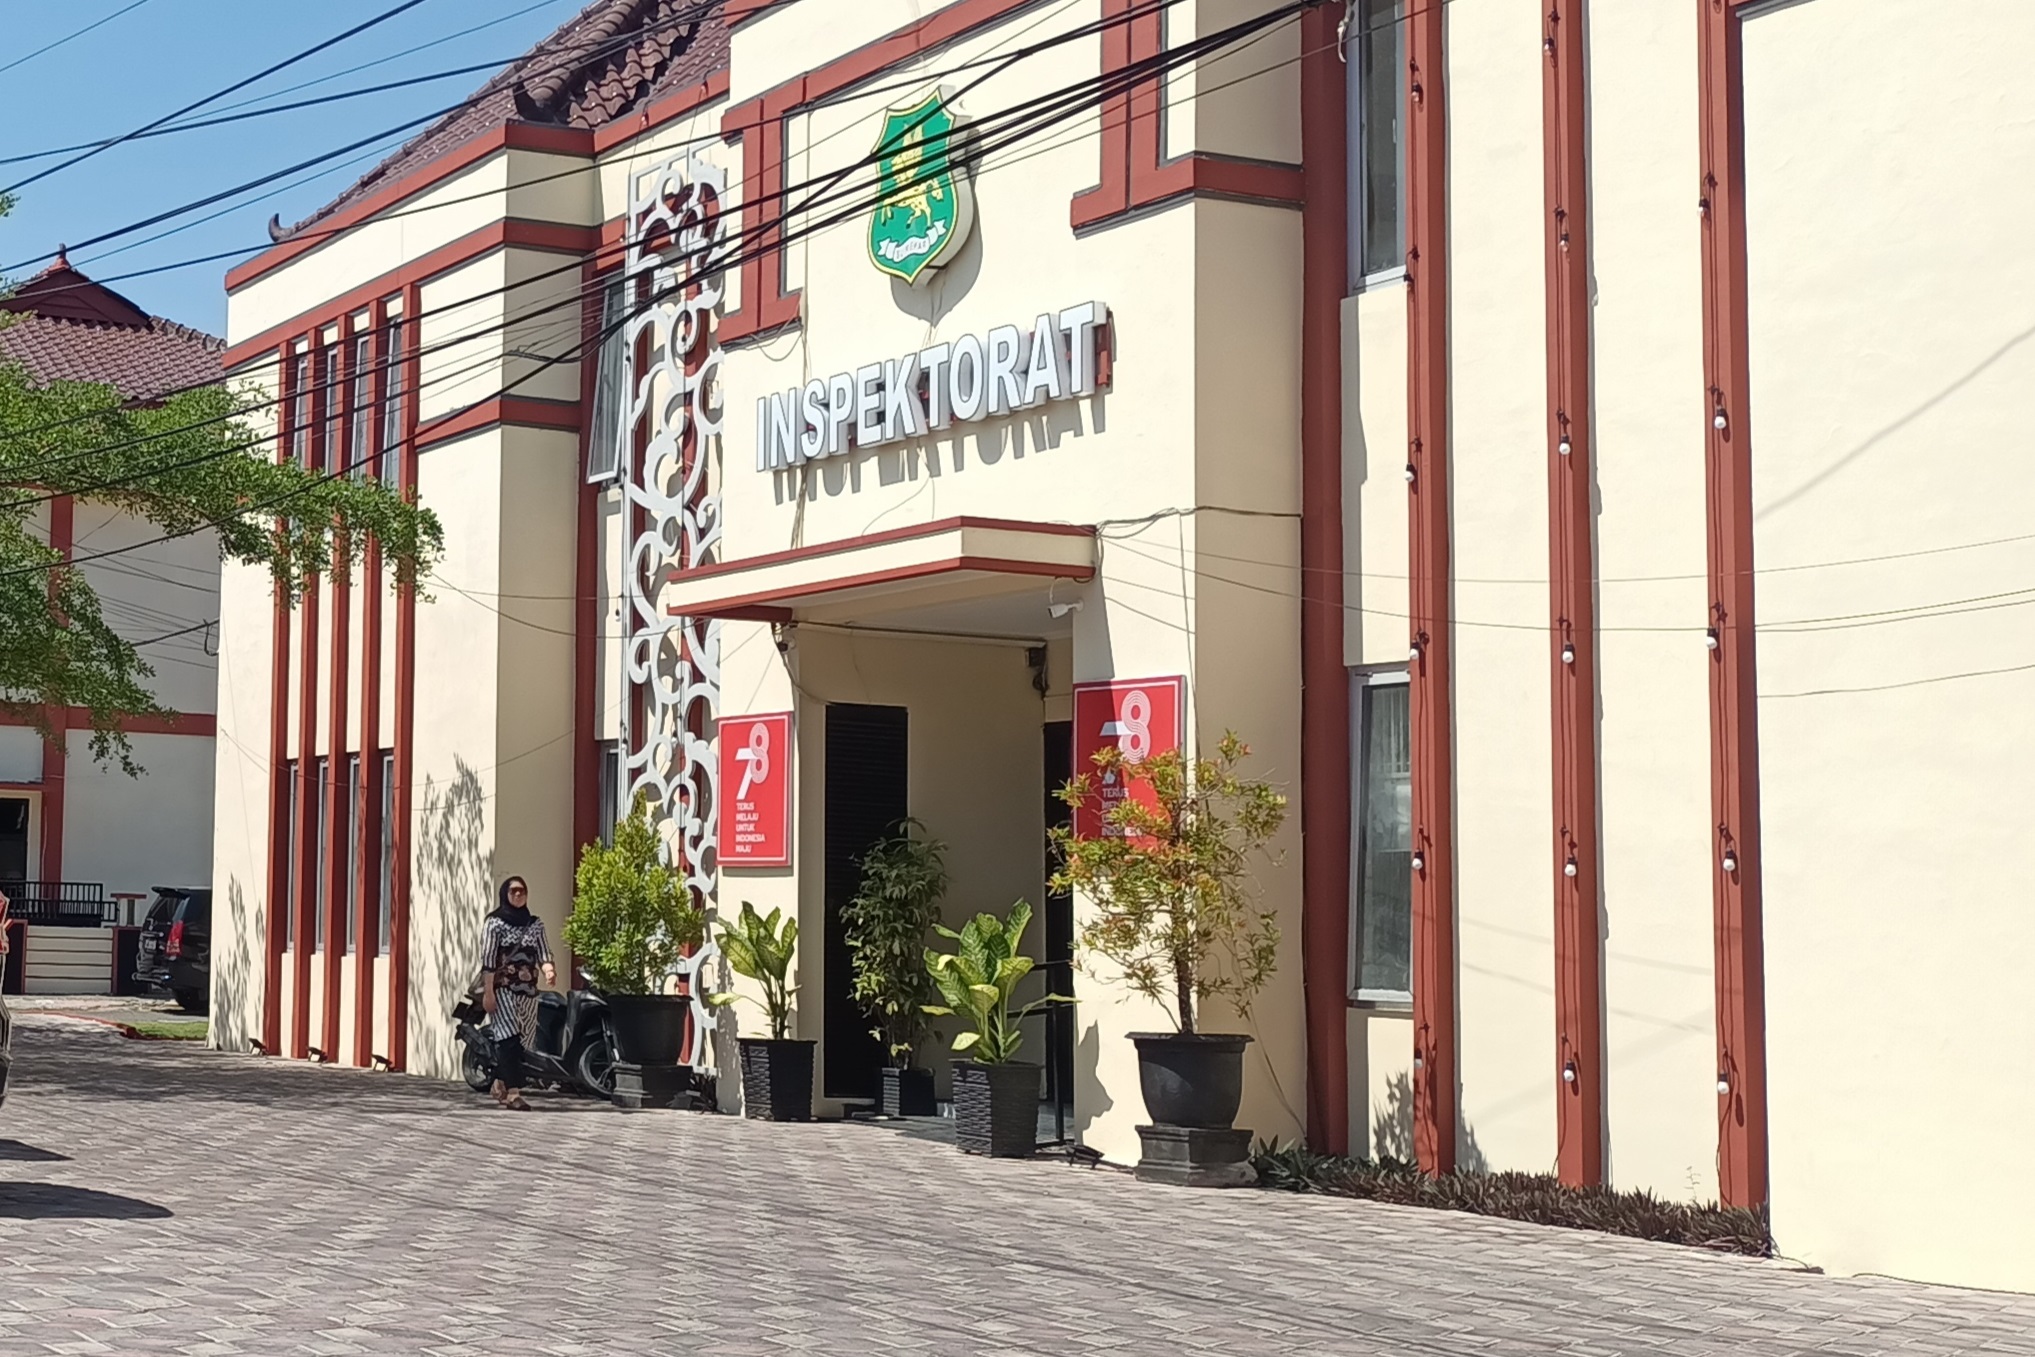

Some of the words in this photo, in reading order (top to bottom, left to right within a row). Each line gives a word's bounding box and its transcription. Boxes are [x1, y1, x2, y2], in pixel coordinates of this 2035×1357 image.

[757, 301, 1105, 473] INSPEKTORAT
[1102, 787, 1129, 798] TERUS
[736, 802, 754, 811] TERUS
[735, 812, 759, 821] MELAJU
[735, 823, 755, 832] UNTUK
[735, 833, 766, 842] INDONESIA
